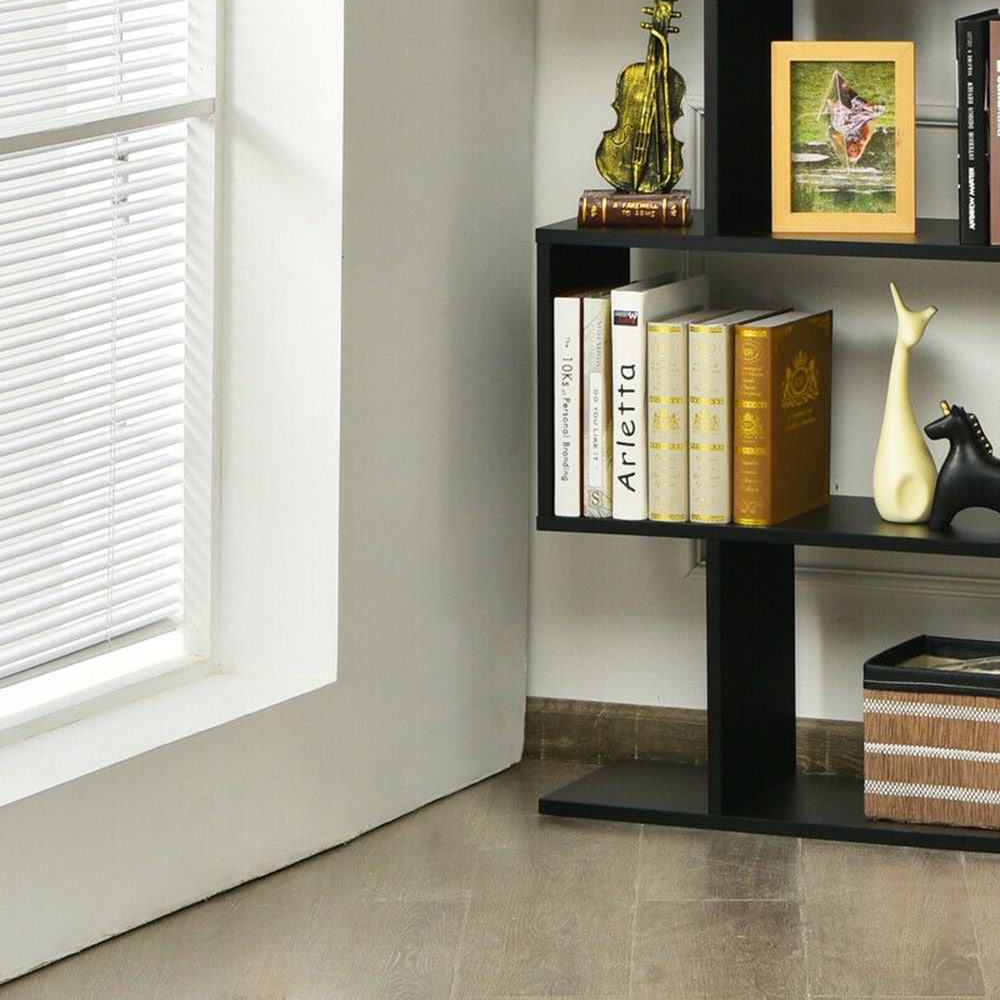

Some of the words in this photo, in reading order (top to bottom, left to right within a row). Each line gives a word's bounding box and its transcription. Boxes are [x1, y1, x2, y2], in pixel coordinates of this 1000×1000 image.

[562, 356, 573, 386] 10Ks
[593, 389, 598, 402] DO
[562, 398, 571, 438] Personal
[616, 363, 636, 492] Arletta
[561, 442, 571, 482] Branding
[593, 452, 598, 461] IT
